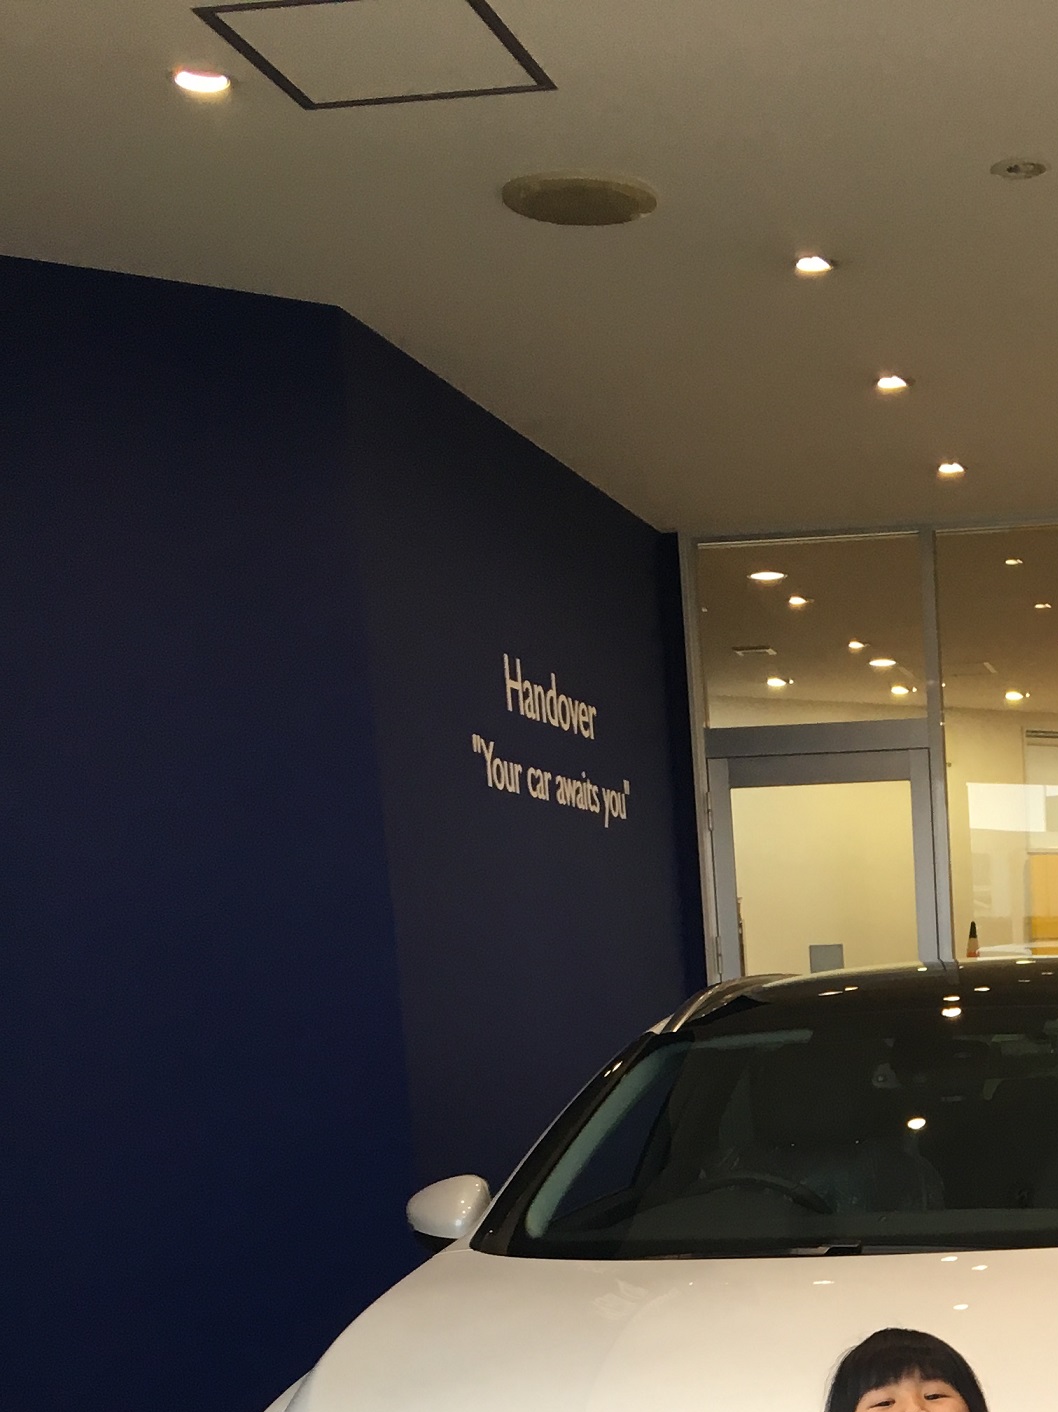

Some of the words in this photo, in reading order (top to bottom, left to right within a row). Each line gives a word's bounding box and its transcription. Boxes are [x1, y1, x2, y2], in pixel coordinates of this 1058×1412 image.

[503, 653, 597, 740] Handover
[471, 733, 523, 795] "Your
[527, 767, 552, 801] car
[555, 771, 601, 814] awaits
[601, 779, 631, 829] you"
